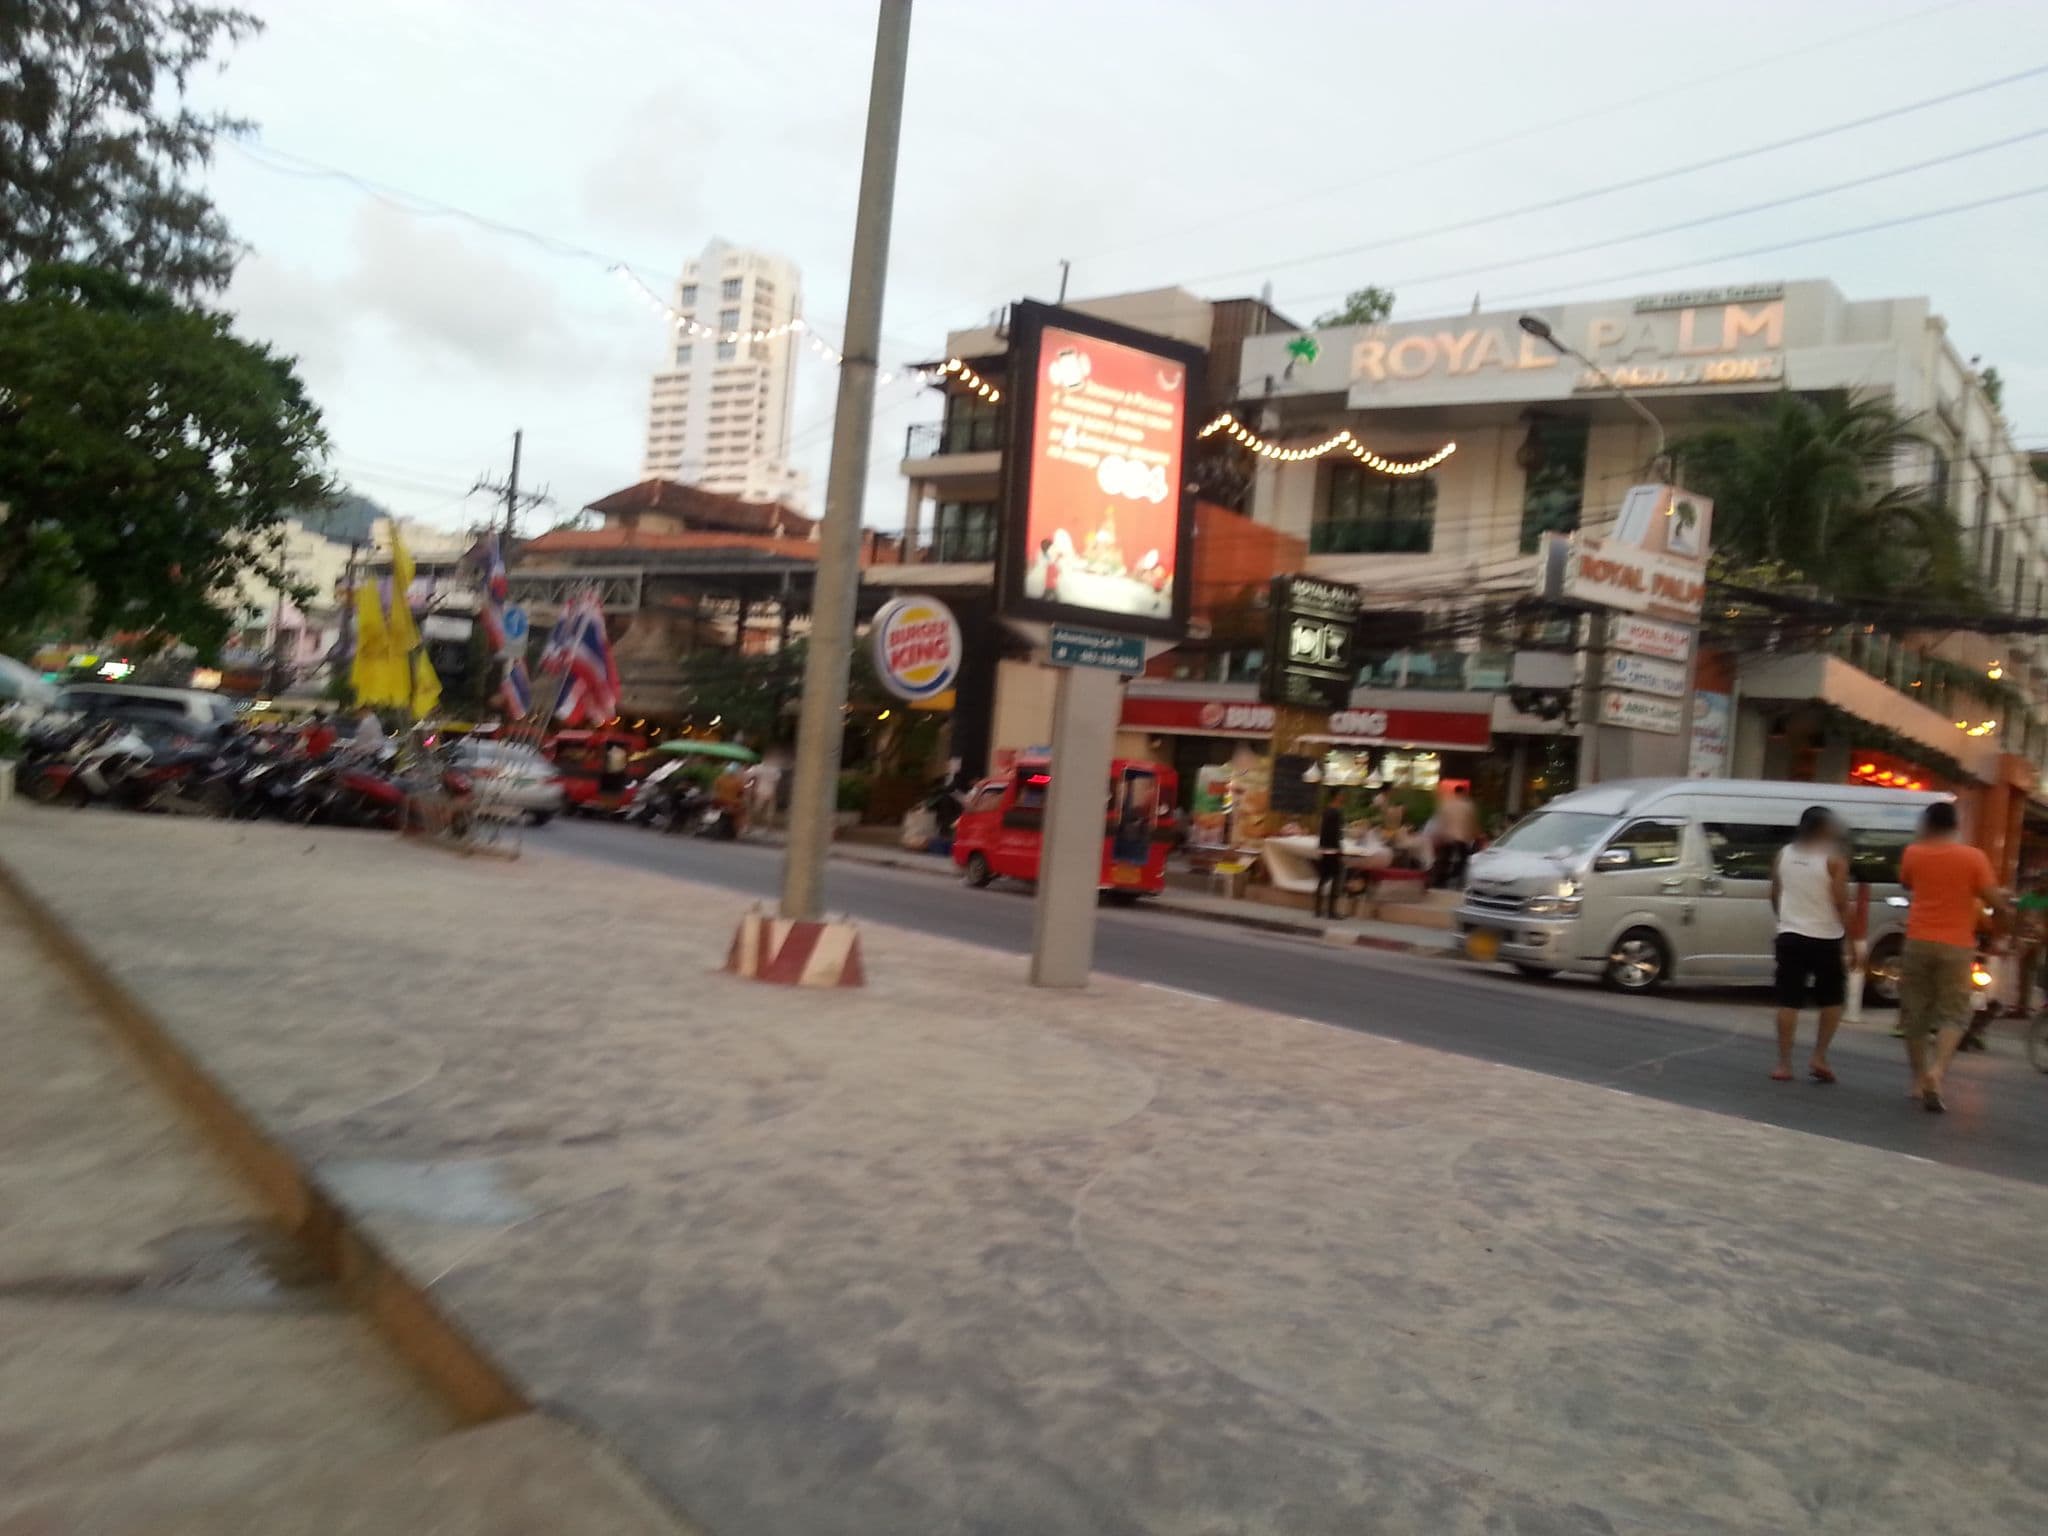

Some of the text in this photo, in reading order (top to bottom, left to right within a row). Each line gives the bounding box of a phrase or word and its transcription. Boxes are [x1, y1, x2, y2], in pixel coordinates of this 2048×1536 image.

[1351, 303, 1784, 381] ROYAL PALM
[1292, 579, 1329, 601] ROYAL
[1580, 554, 1645, 593] ROYAL
[889, 620, 950, 646] BURGER
[891, 639, 950, 673] KING
